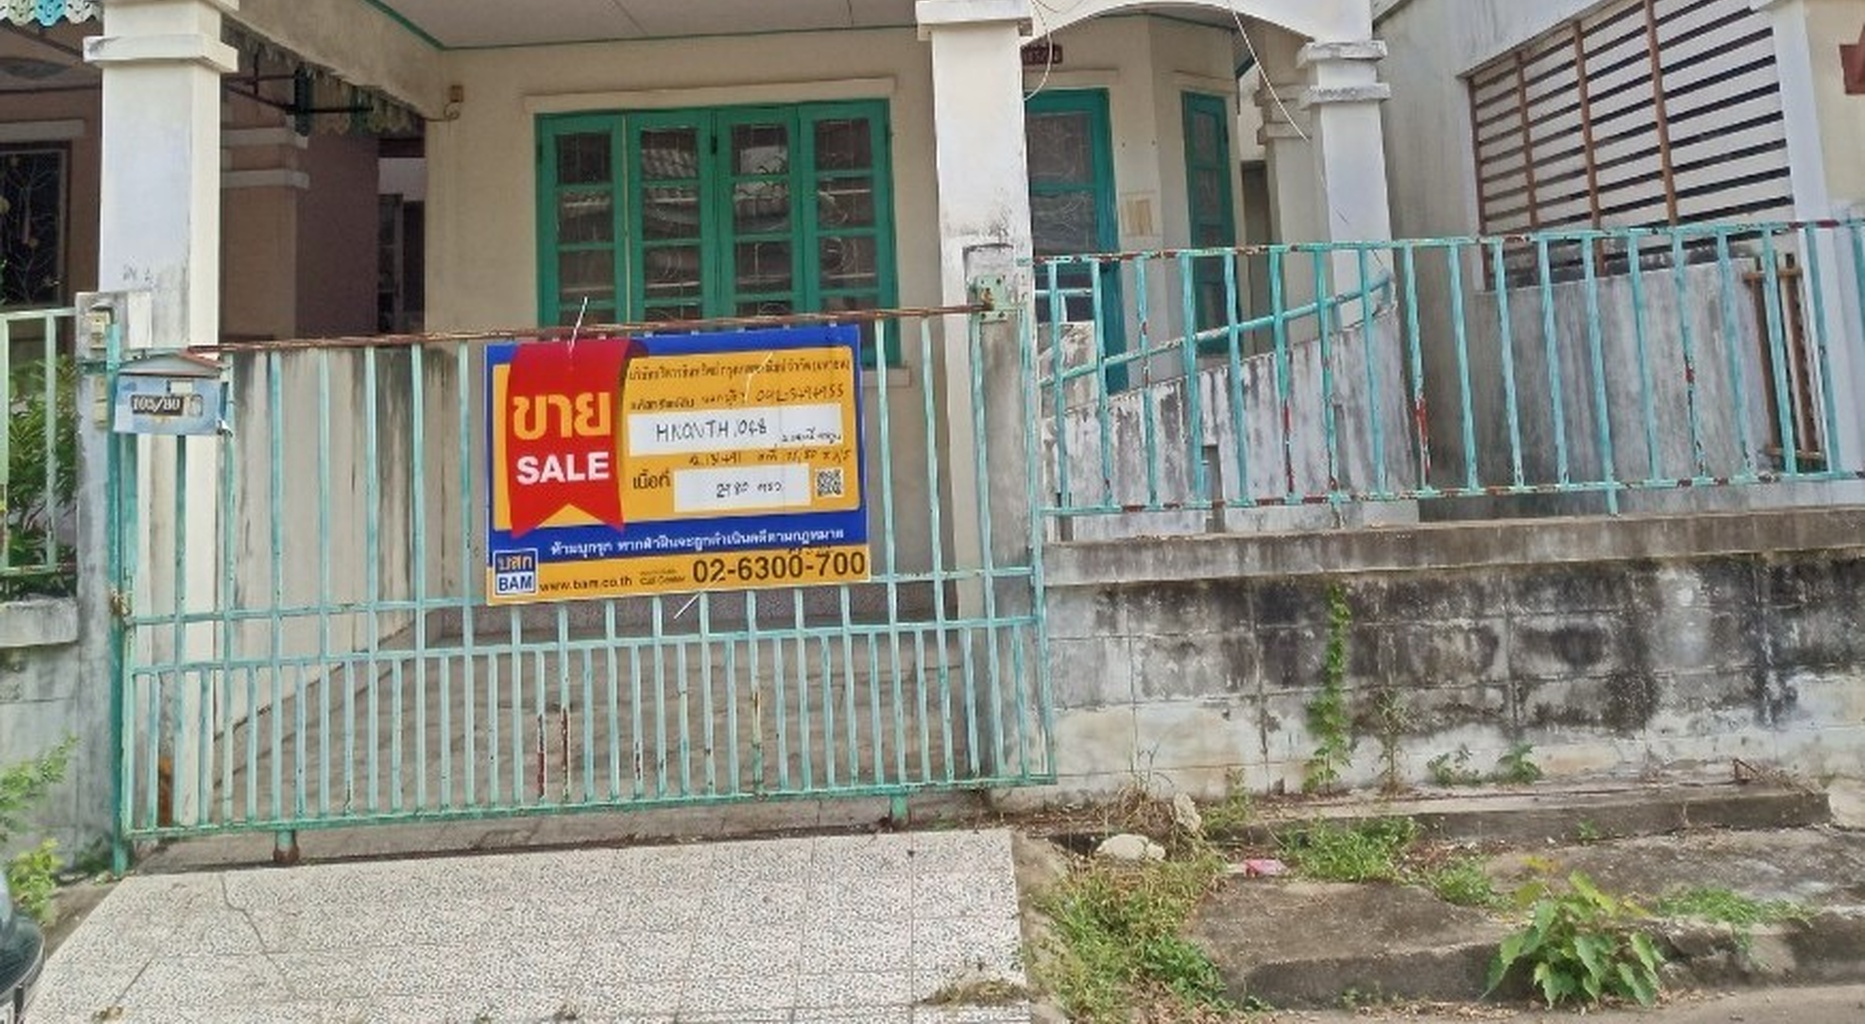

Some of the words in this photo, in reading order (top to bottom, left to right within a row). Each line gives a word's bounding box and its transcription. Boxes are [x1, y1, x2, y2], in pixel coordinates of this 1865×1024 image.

[513, 392, 611, 440] ขาย
[516, 451, 610, 485] SALE
[633, 467, 671, 489] เนื้อที่
[692, 551, 866, 583] 02-6300-700
[498, 575, 533, 592] BAM
[539, 576, 633, 592] www.bam.co.th
